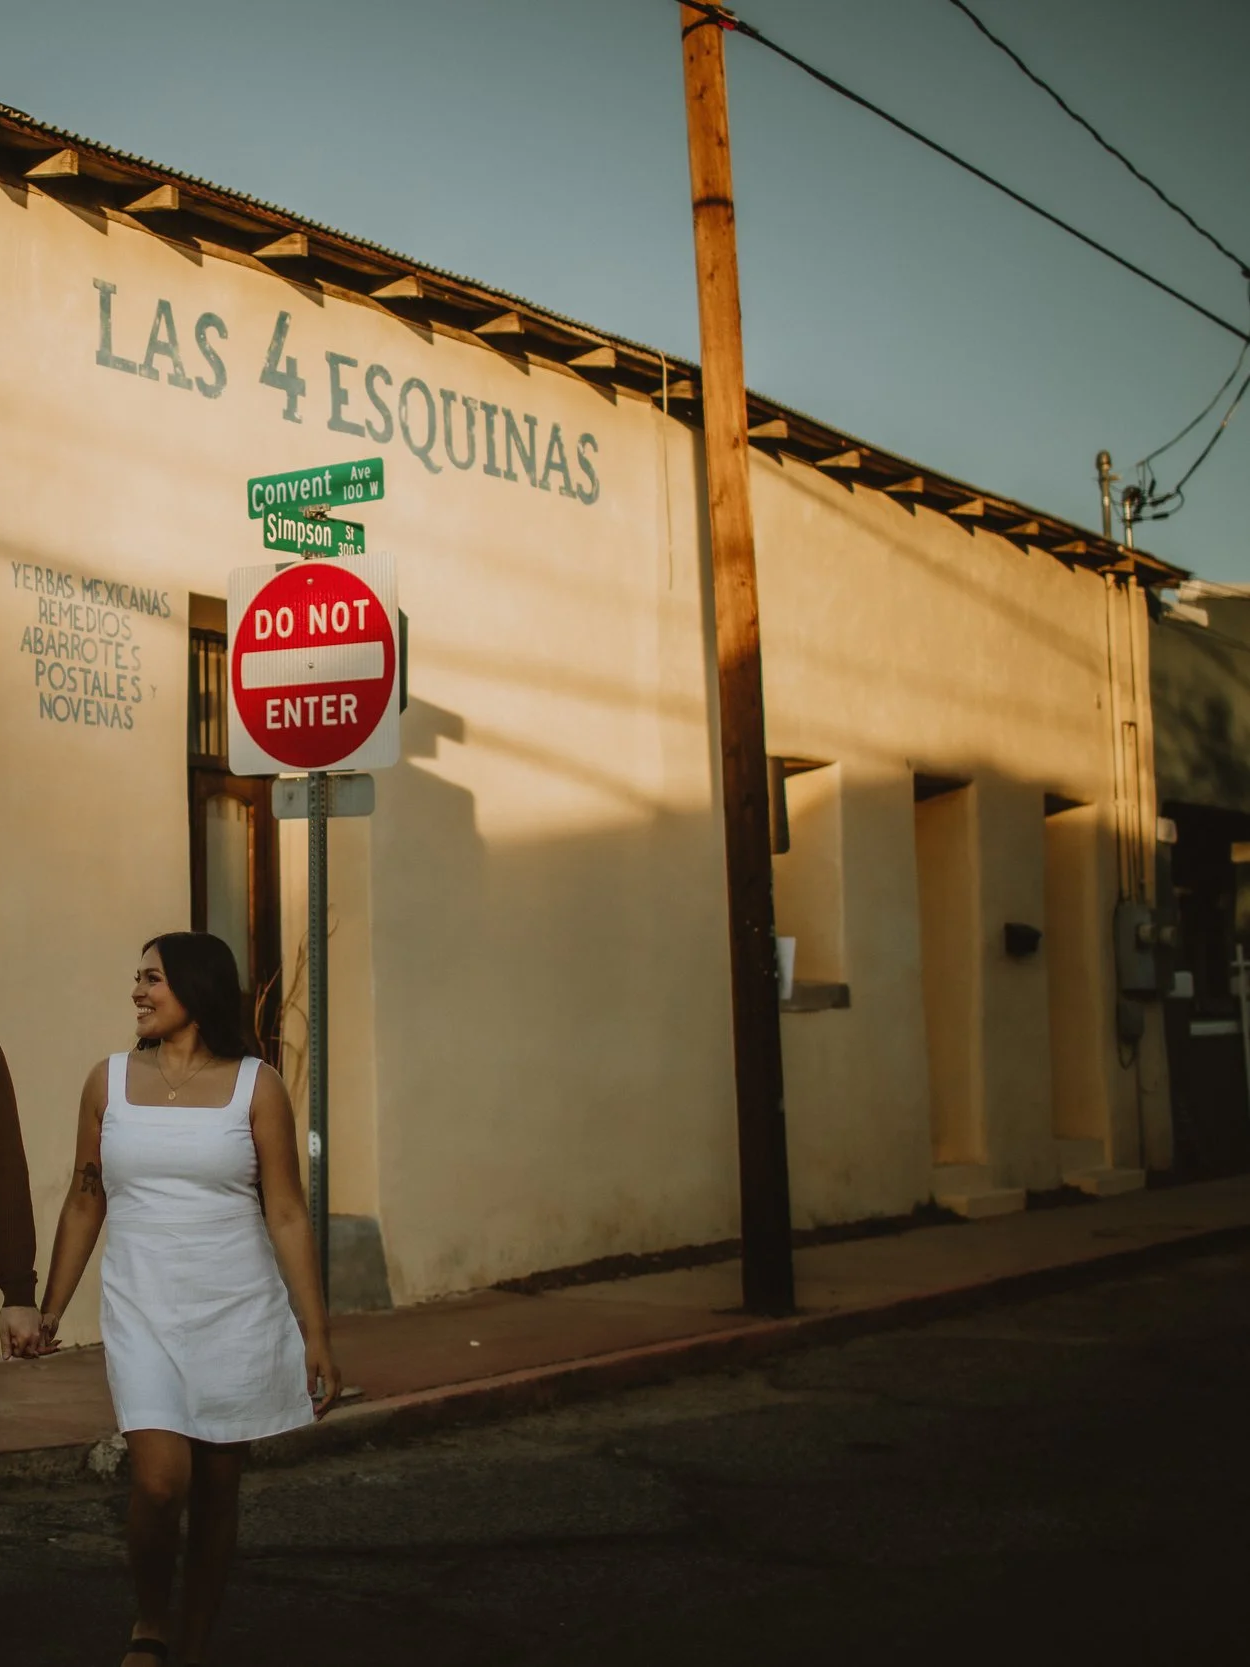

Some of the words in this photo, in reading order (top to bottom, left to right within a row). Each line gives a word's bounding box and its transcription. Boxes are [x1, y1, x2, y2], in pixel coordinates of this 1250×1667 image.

[93, 278, 228, 399] LAS
[259, 311, 306, 424] 4
[325, 350, 601, 506] ESQUINAS
[252, 470, 332, 512] Convent
[350, 466, 371, 481] Ave
[343, 483, 363, 500] 100
[369, 481, 379, 496] W
[267, 512, 332, 548] Simpson
[345, 525, 354, 541] St
[338, 542, 354, 556] 300
[11, 561, 75, 599] YERBAS
[81, 575, 171, 618] MEXICANAS
[38, 596, 132, 641] REMEDIOS
[255, 607, 294, 640] DO
[309, 599, 370, 636] NOT
[20, 626, 141, 672] ABARROTES
[35, 658, 143, 704] POSTALES
[150, 684, 158, 698] Y
[39, 691, 134, 730] NOVENAS
[266, 694, 358, 730] ENTER
